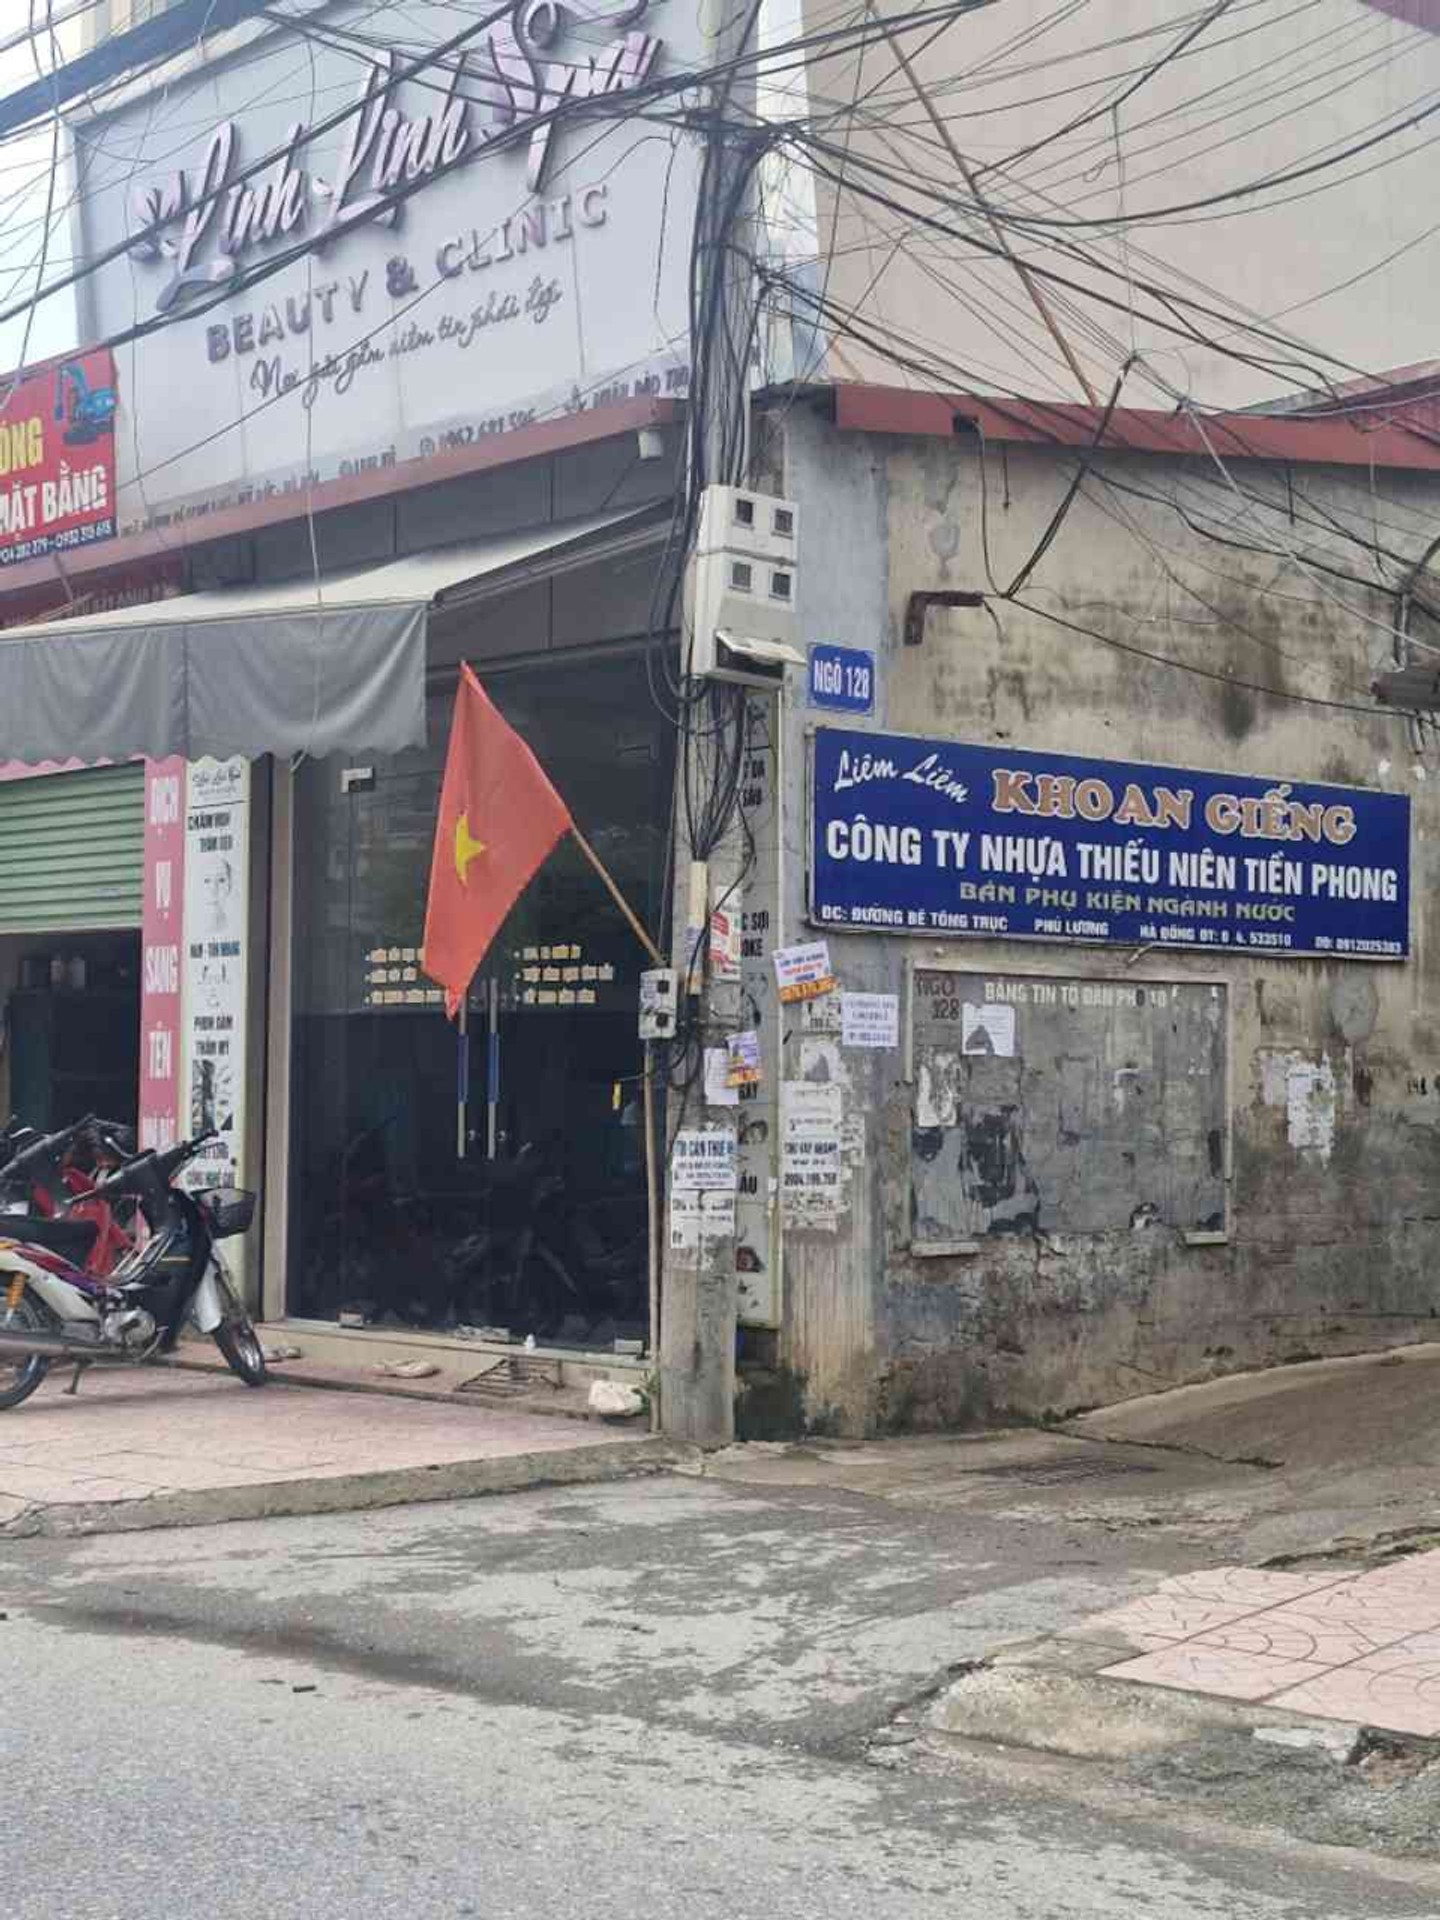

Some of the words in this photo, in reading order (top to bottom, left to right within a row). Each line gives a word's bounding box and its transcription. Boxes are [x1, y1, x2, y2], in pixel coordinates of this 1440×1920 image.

[206, 269, 370, 364] BEAUTY
[386, 255, 419, 298] &
[435, 185, 608, 279] CLINIC
[42, 459, 107, 524] BẰNG
[846, 666, 870, 699] 128
[833, 750, 898, 793] Liêm
[902, 753, 971, 804] Liêm
[991, 769, 1193, 830] KHOAN
[1205, 784, 1357, 845] GIẾNG
[826, 814, 922, 866] CÔNG
[931, 829, 971, 870] TY
[980, 835, 1067, 883] NHỰA
[1076, 837, 1159, 885] THIẾU
[1168, 848, 1235, 891] NIÊN
[1245, 850, 1303, 896] TIỀN
[1311, 862, 1398, 902] PHONG
[960, 879, 1016, 902] BÁN
[1025, 886, 1078, 909] PHỤ
[1086, 889, 1142, 916] KIỆN
[1147, 893, 1229, 919] NGÀNH
[1235, 898, 1296, 922] NƯỚC
[1032, 983, 1058, 1004] TIN
